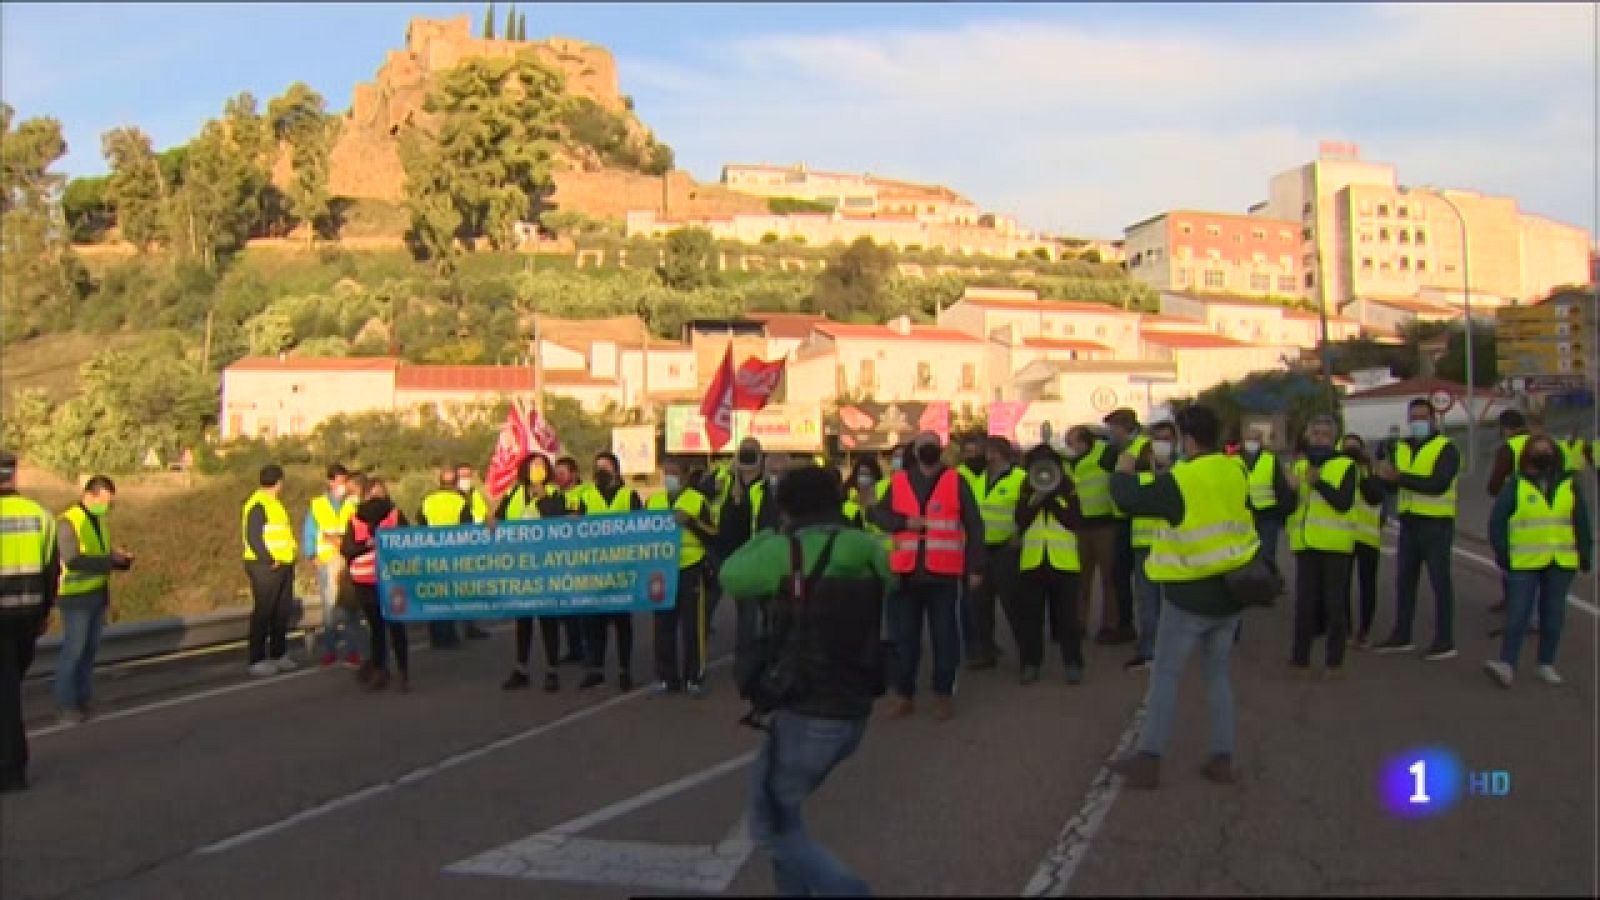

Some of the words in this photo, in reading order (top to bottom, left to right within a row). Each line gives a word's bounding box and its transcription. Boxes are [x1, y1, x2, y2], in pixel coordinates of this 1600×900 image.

[381, 527, 491, 549] TRABAJAMOS
[495, 523, 544, 543] PERO
[549, 522, 574, 540] NO
[578, 514, 676, 538] COBRAMOS
[382, 555, 421, 581] ¿QUÉ
[426, 554, 449, 574] HA
[455, 552, 515, 573] HECHO
[519, 552, 539, 570] EL
[544, 541, 676, 568] AYUNTAMIENTO
[416, 580, 448, 598] CON
[454, 575, 544, 597] NUESTRAS
[549, 570, 638, 593] NÓMINAS?
